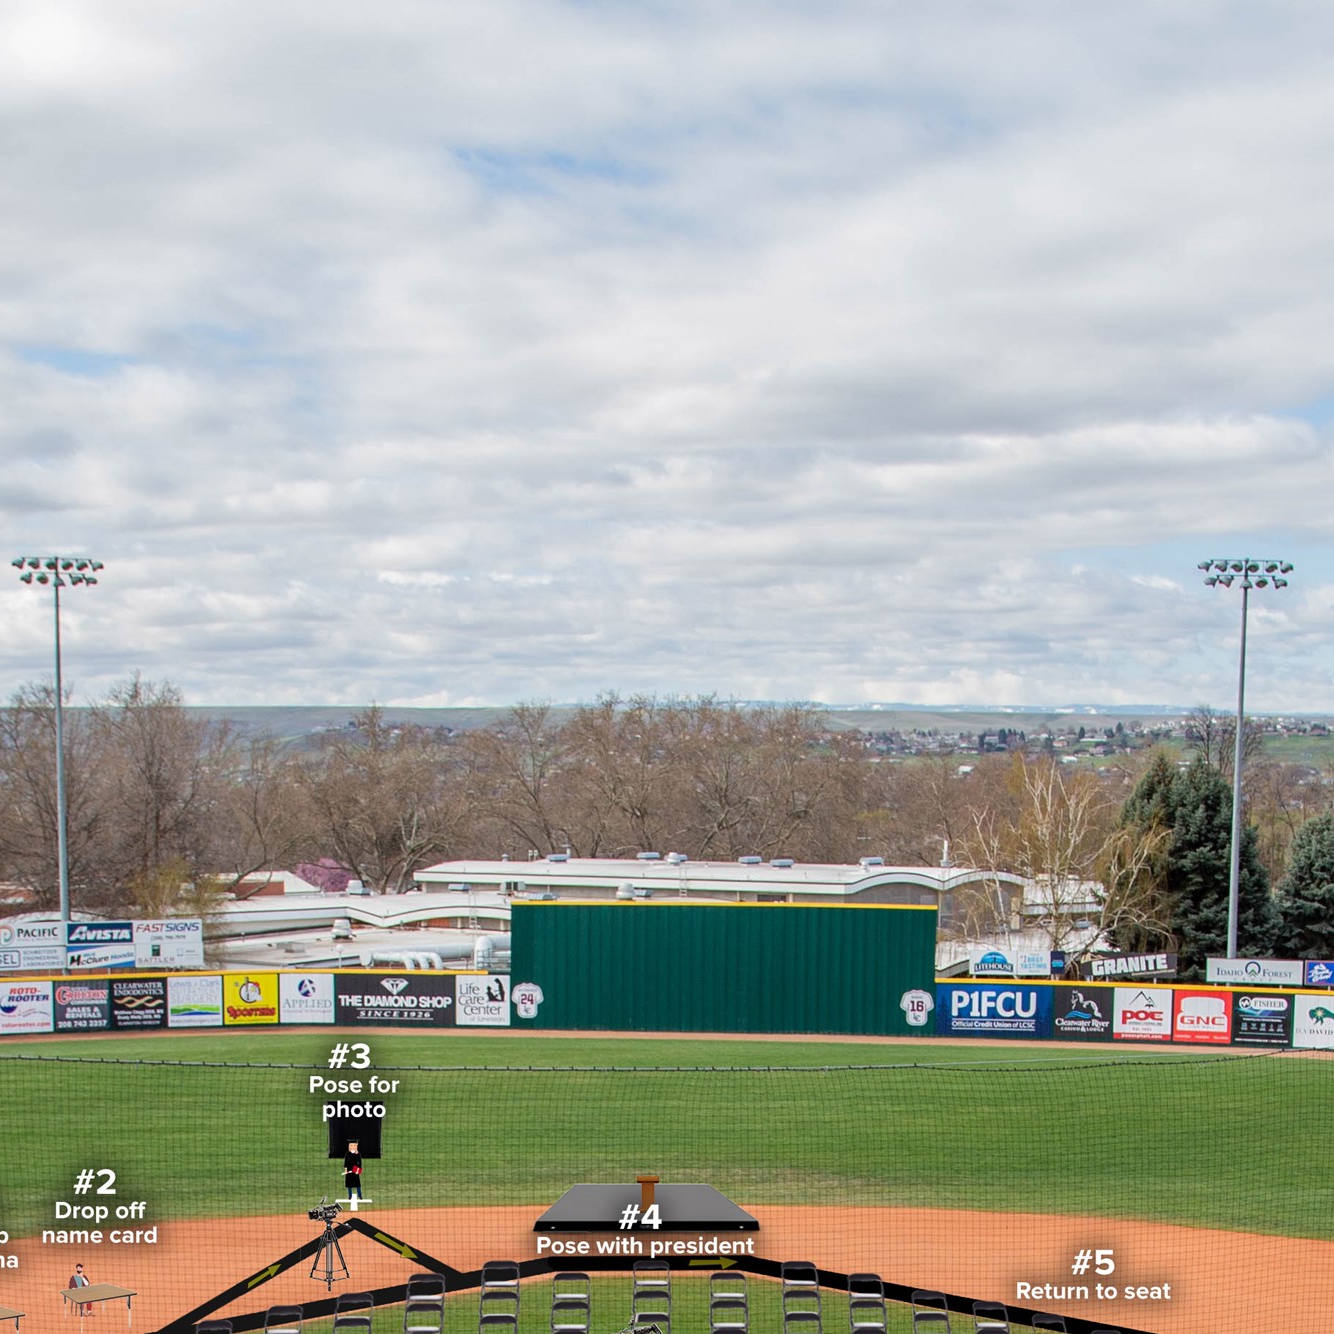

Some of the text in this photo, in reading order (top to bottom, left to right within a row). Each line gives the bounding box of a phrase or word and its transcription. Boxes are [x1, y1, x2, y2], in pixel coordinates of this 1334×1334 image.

[17, 927, 58, 937] PACIFIC
[136, 922, 200, 932] FASTSIGNS
[69, 926, 132, 941] AVISTA
[974, 963, 1014, 972] LITEHOUSE
[1091, 953, 1167, 976] GRANITE
[1216, 967, 1293, 979] IDAHO FOREST
[9, 987, 42, 995] ROTO-
[113, 982, 162, 990] CLEARWATER
[459, 983, 480, 995] Life
[113, 988, 164, 996] ENDODONTICS
[8, 994, 50, 1002] ROOTER
[282, 998, 333, 1008] APPLIED
[338, 995, 452, 1008] THE DIAMOND SHOP
[458, 994, 485, 1006] Care
[520, 993, 534, 1005] 24
[910, 1000, 924, 1012] 16
[951, 990, 1037, 1018] P1FCU
[1253, 1000, 1285, 1008] FISHER
[359, 1010, 399, 1018] SINCE
[463, 1004, 503, 1016] Center
[952, 1020, 973, 1028] Official
[1091, 1018, 1110, 1028] River
[1179, 1015, 1225, 1026] GNC
